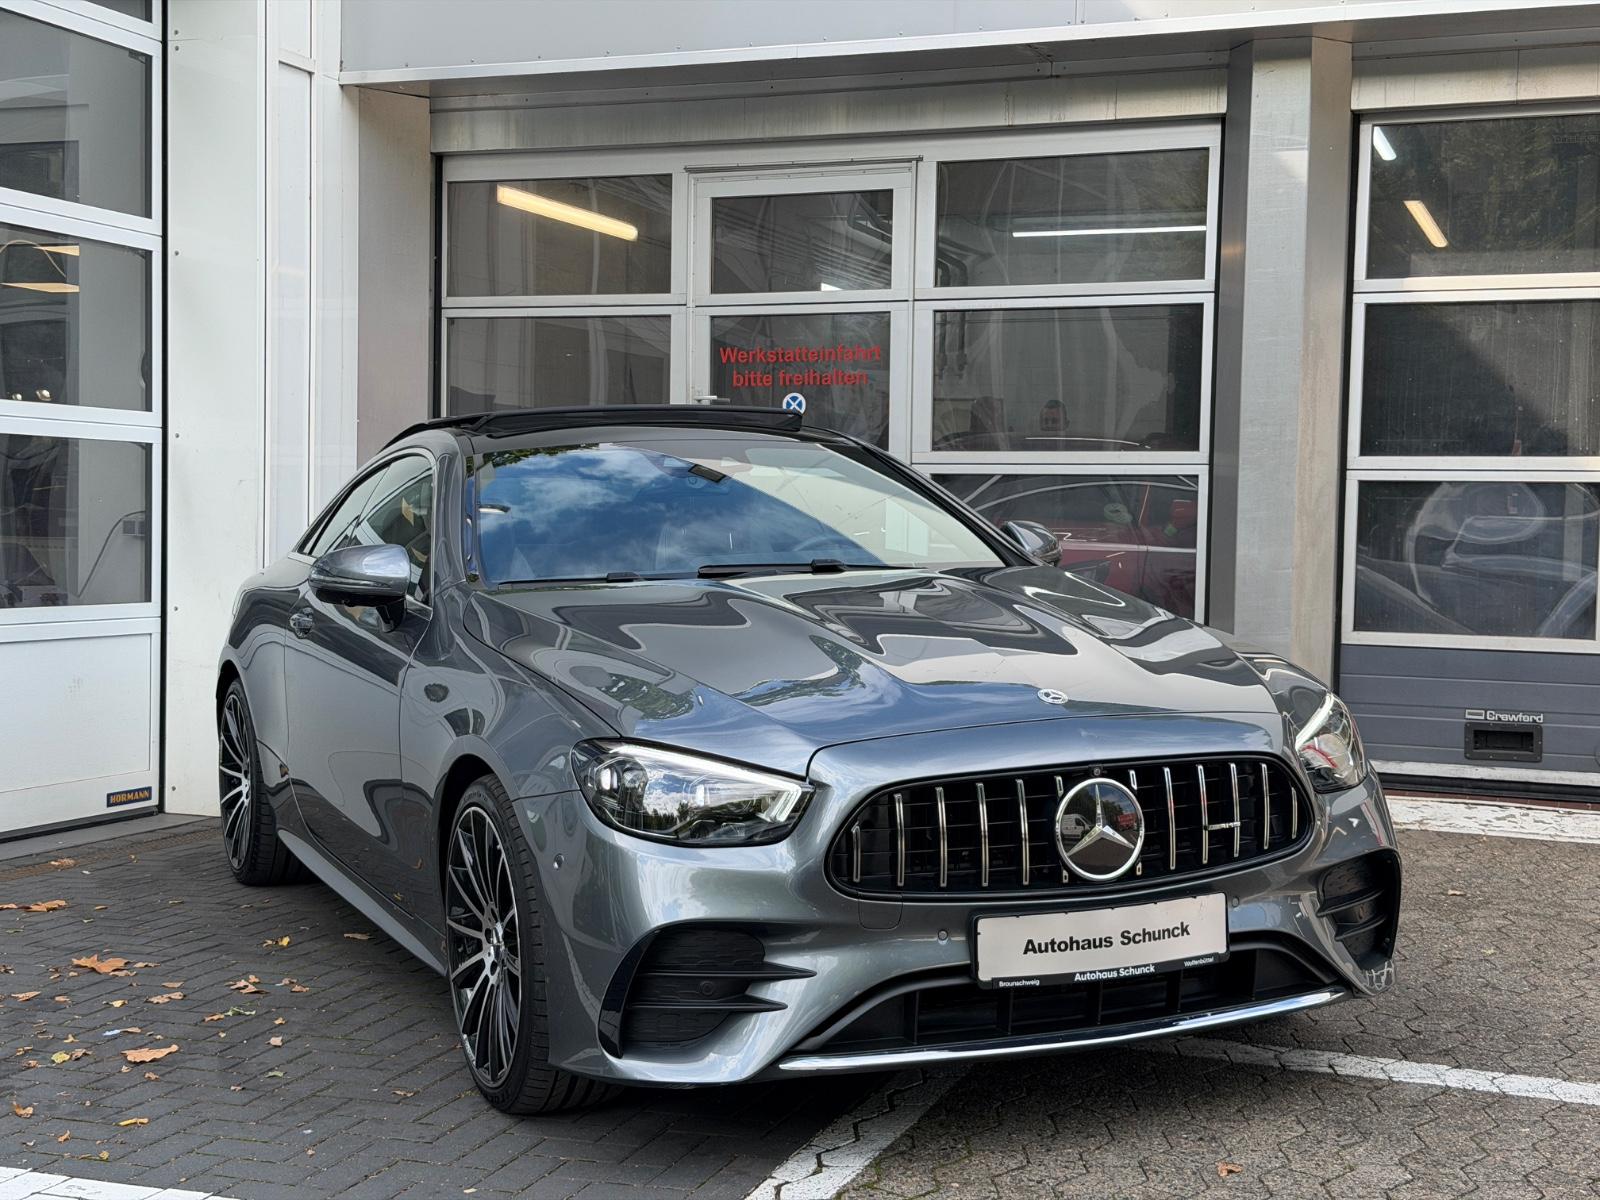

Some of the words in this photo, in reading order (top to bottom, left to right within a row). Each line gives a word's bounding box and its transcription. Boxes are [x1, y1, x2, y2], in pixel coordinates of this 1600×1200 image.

[719, 344, 881, 364] Werkstatteinfahrt
[732, 368, 773, 387] bitte
[778, 367, 868, 386] freihalten
[1486, 710, 1544, 723] Crawford
[1023, 936, 1114, 955] Autohaus
[1120, 921, 1191, 946] Schunck
[1074, 970, 1118, 982] Autohaus
[1119, 962, 1156, 977] Schunck
[998, 979, 1040, 988] Braunschweig
